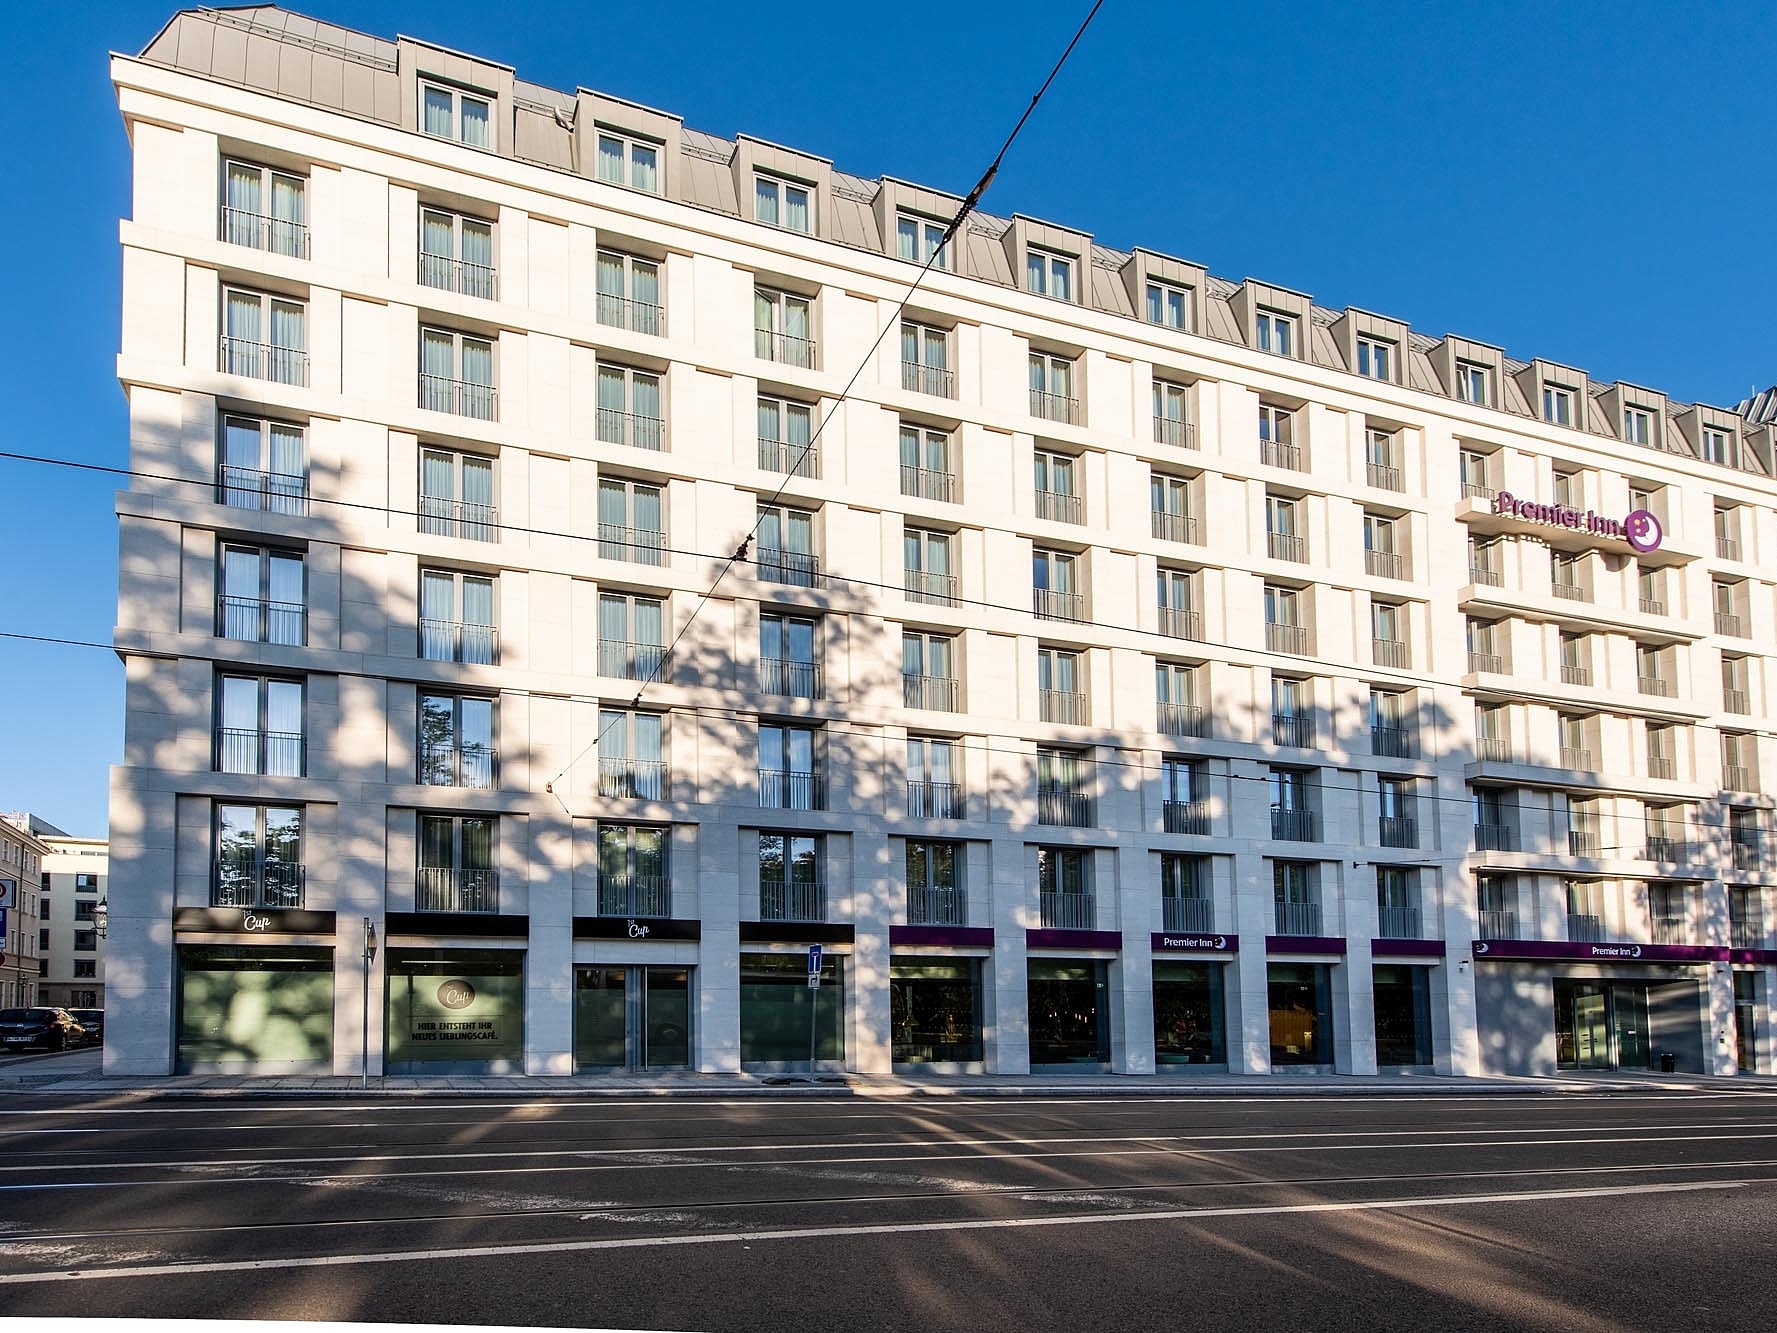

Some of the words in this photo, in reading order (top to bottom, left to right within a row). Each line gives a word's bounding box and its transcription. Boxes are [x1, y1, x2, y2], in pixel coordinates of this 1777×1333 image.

[1497, 491, 1585, 529] Premier
[1587, 510, 1620, 536] Inn
[244, 915, 271, 931] Cup
[628, 924, 650, 938] Cup
[1164, 937, 1198, 947] Premier
[1200, 938, 1213, 947] Inn
[1592, 946, 1619, 956] Premier
[1620, 947, 1631, 956] Inn
[447, 990, 471, 1004] Cup
[418, 1022, 436, 1030] HIER
[439, 1022, 476, 1030] ENTSTEHT
[478, 1021, 493, 1030] IHR
